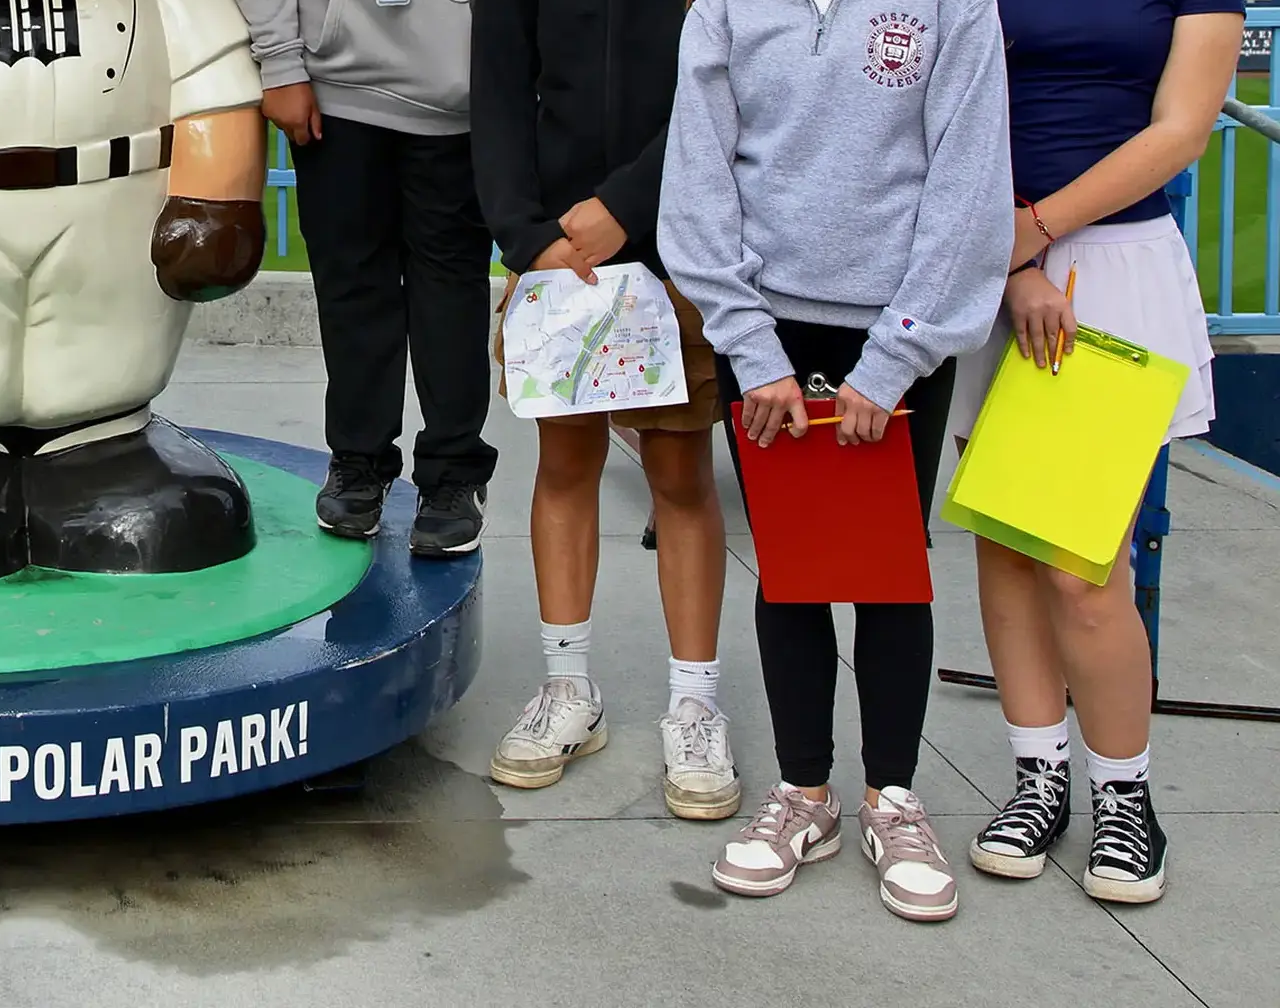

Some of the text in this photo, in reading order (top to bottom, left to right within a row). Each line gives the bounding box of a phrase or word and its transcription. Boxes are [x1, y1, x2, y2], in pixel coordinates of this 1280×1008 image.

[869, 12, 929, 34] BOSTON
[862, 65, 922, 88] COLLEGE
[179, 700, 309, 784] PARK!
